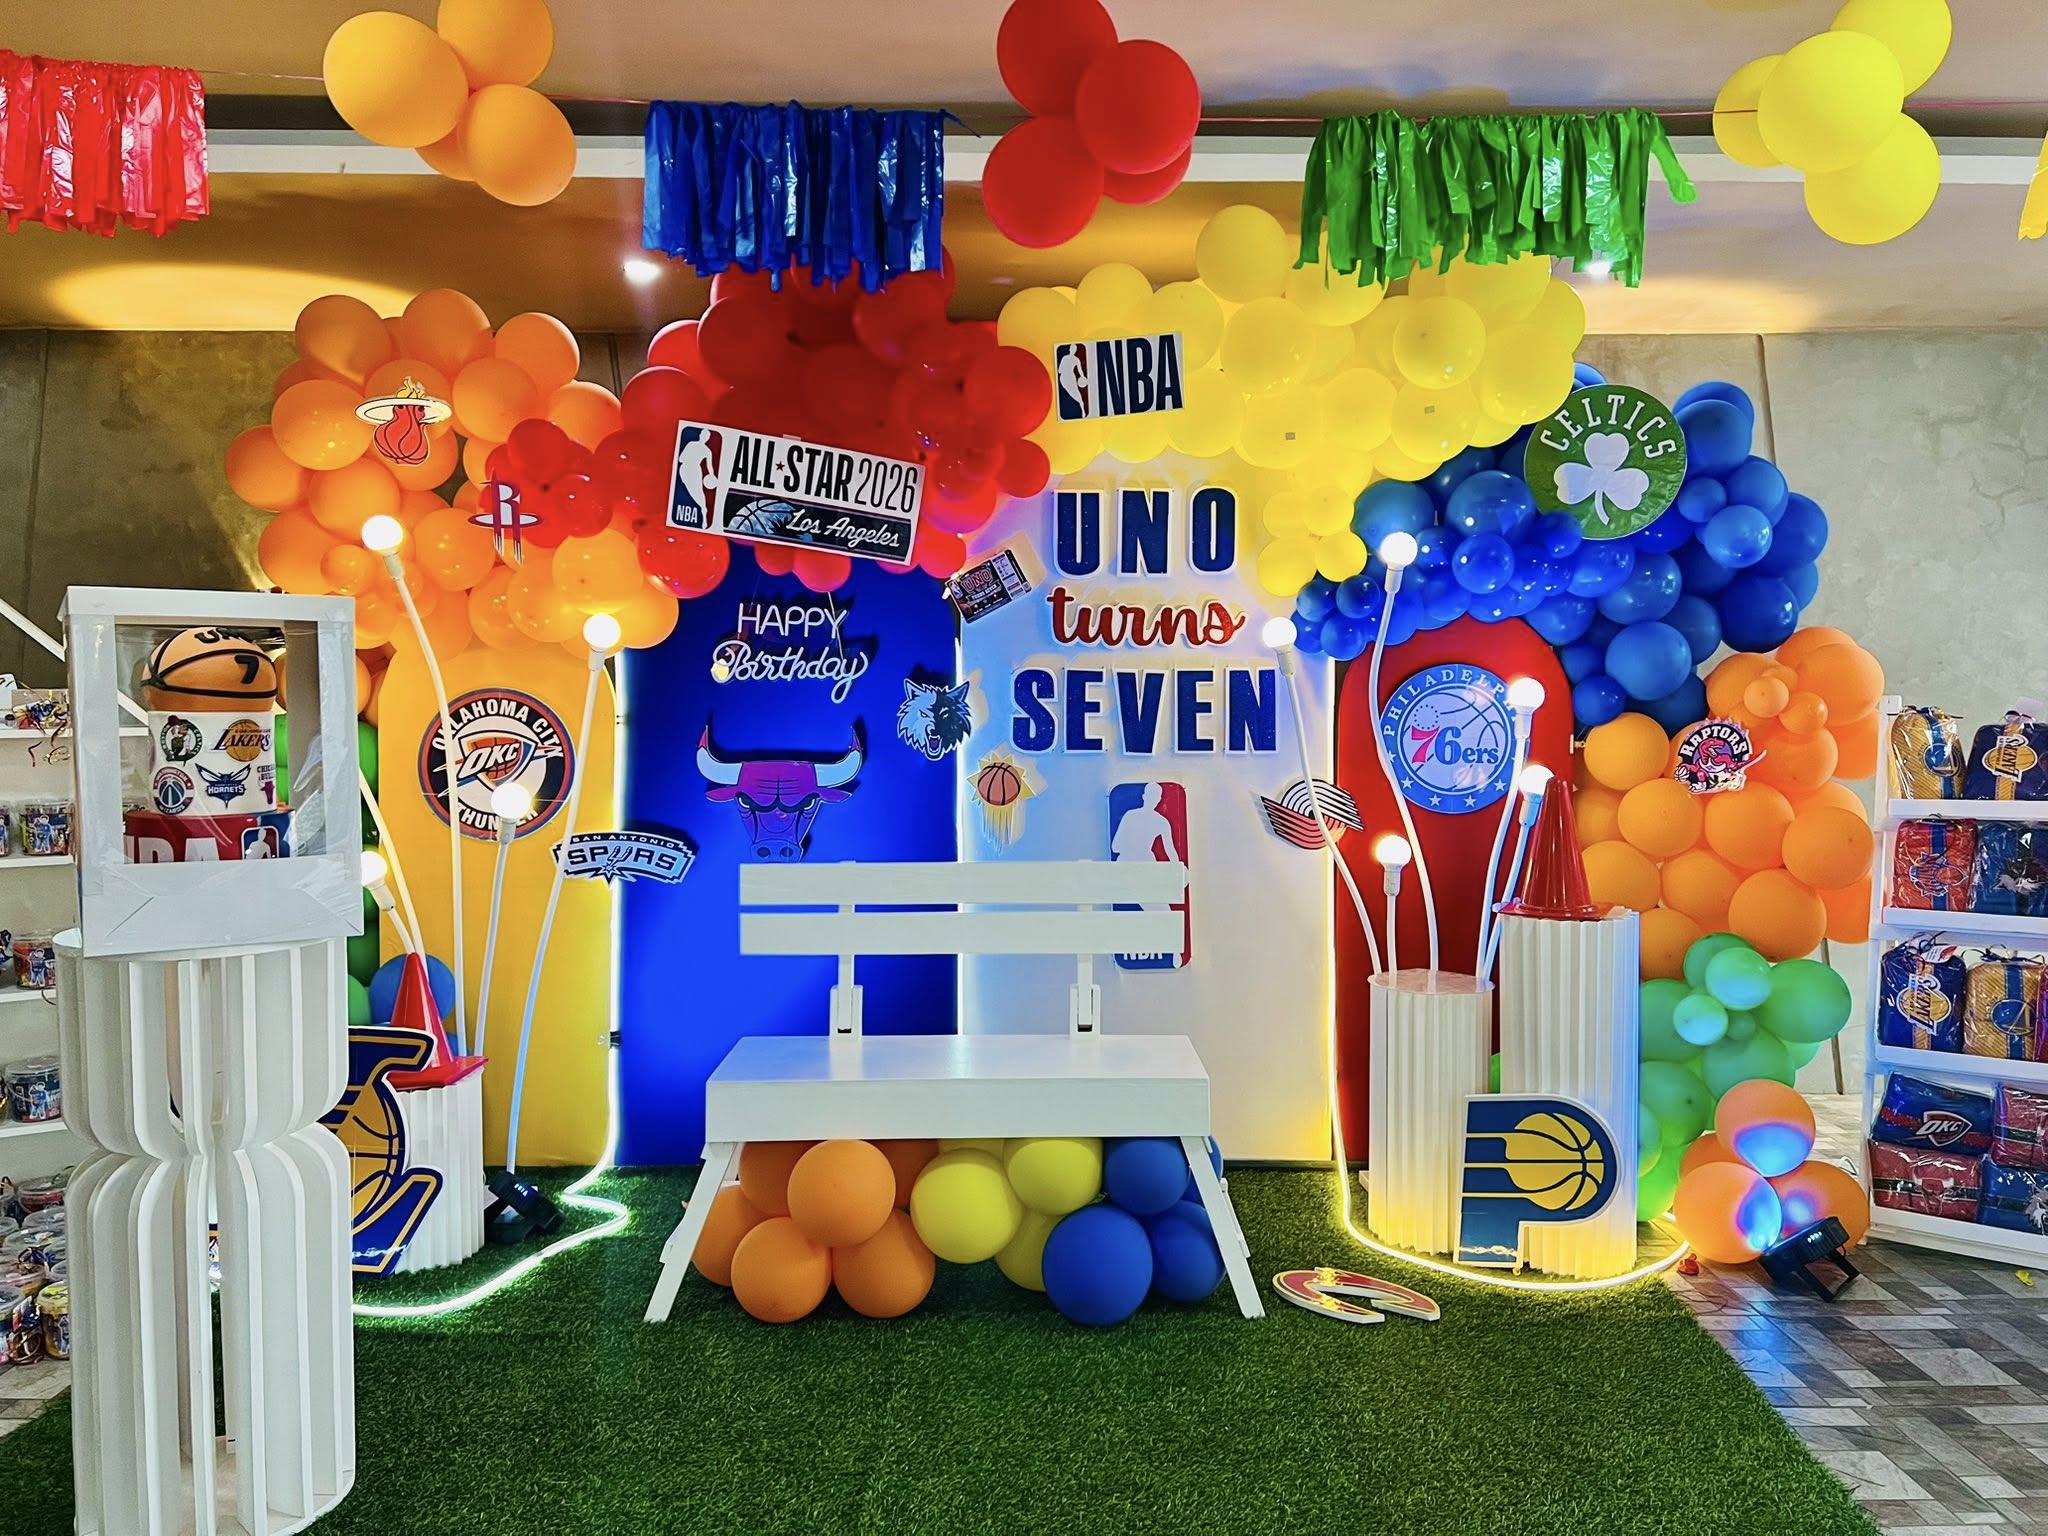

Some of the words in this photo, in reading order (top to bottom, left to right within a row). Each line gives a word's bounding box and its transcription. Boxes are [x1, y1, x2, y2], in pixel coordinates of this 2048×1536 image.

[1096, 334, 1184, 417] NBA
[1540, 394, 1676, 458] CELTICS
[855, 458, 918, 513] 2026
[676, 504, 698, 524] NBA
[786, 509, 821, 534] Los
[824, 517, 900, 549] Angeles
[1057, 487, 1238, 577] UNO
[738, 603, 849, 639] HAPPY
[1047, 587, 1246, 647] turns
[234, 655, 259, 684] 7
[711, 640, 868, 704] Birthday
[1012, 668, 1277, 752] SEVEN
[1384, 669, 1517, 737] PHILADELP
[211, 728, 271, 752] LAKERS
[1411, 725, 1499, 765] 76ers
[1680, 726, 1748, 757] RAPTORS
[458, 743, 519, 779] OKC
[208, 784, 244, 795] HORNETS
[568, 846, 678, 871] SPURS
[573, 835, 601, 843] SAN
[609, 834, 675, 849] ANTONIO
[1916, 1120, 1962, 1135] OKC
